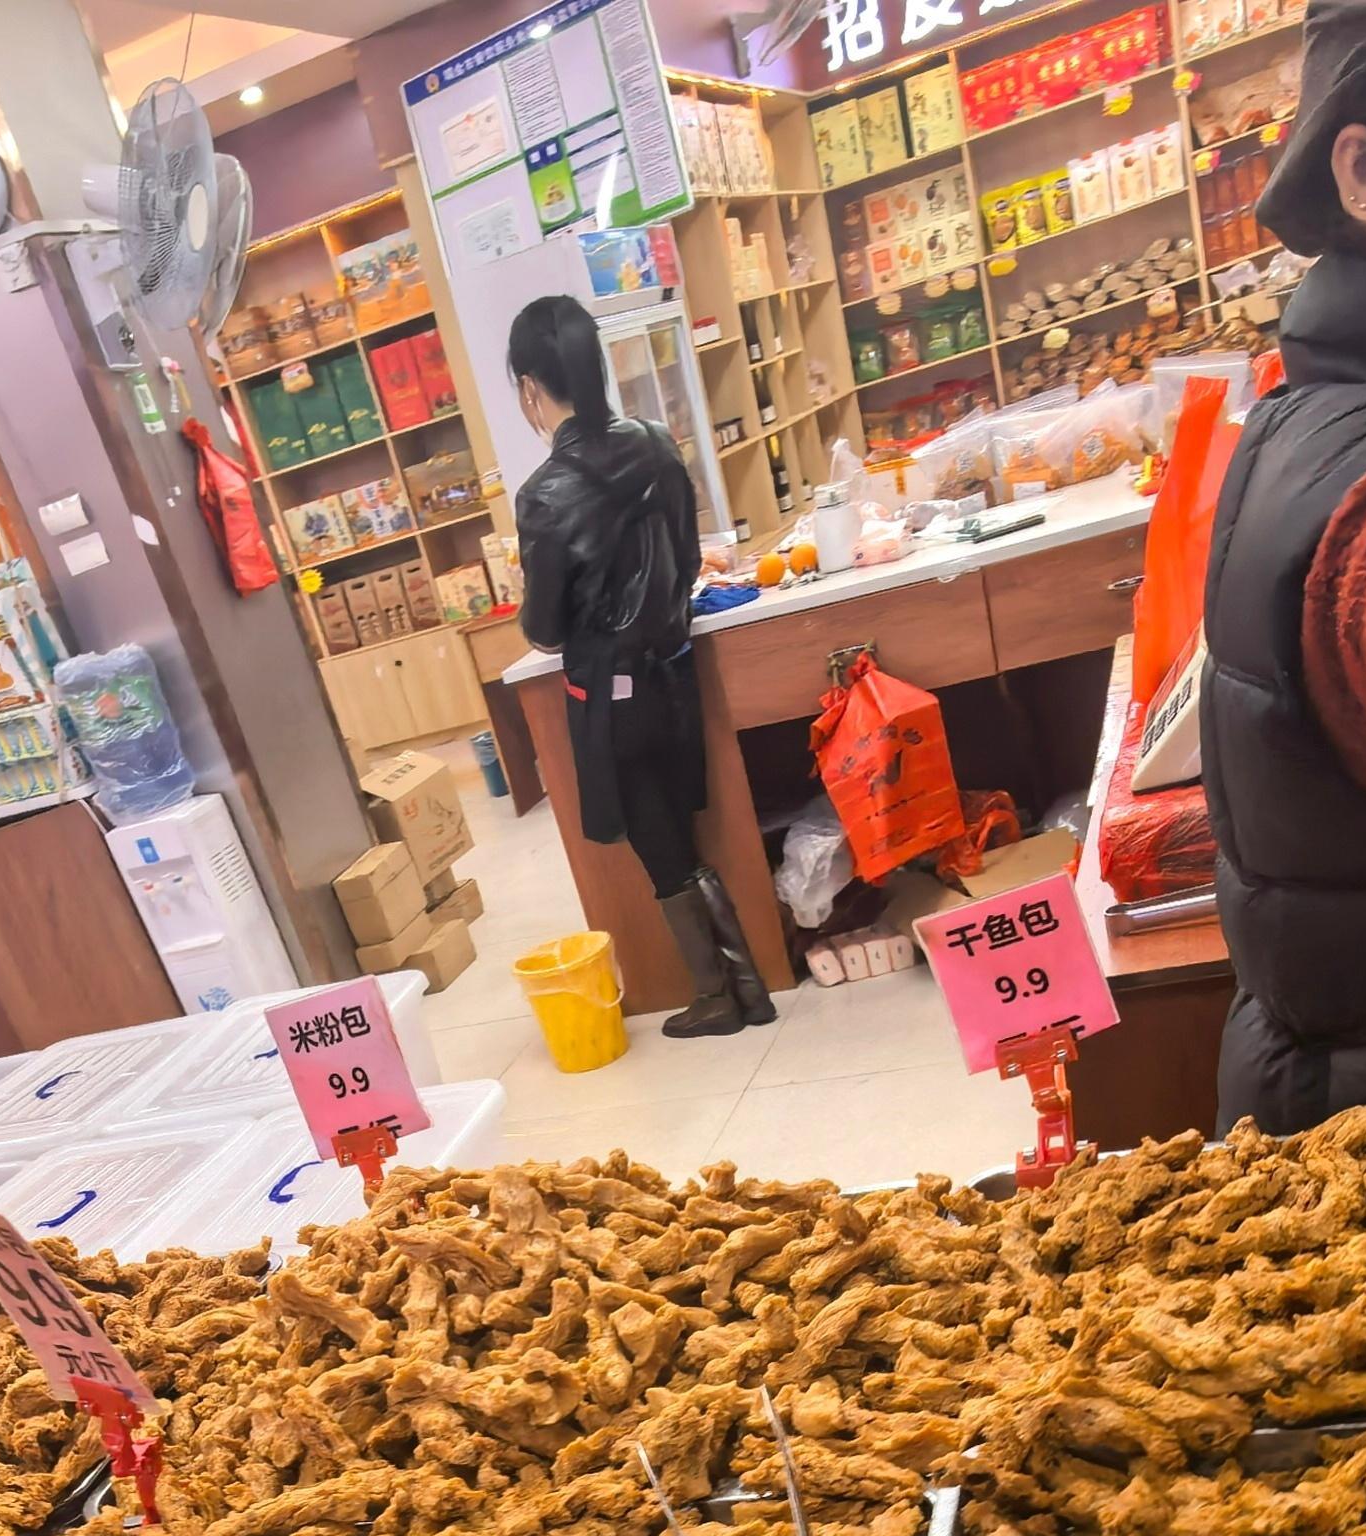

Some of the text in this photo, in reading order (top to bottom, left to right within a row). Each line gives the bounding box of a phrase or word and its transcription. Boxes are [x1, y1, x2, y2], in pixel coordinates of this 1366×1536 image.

[945, 900, 1059, 957] 干鱼包
[995, 967, 1050, 1004] 9.9
[288, 1005, 371, 1053] 米粉包
[328, 1066, 371, 1099] 9.9
[53, 1344, 122, 1384] 元/斤
